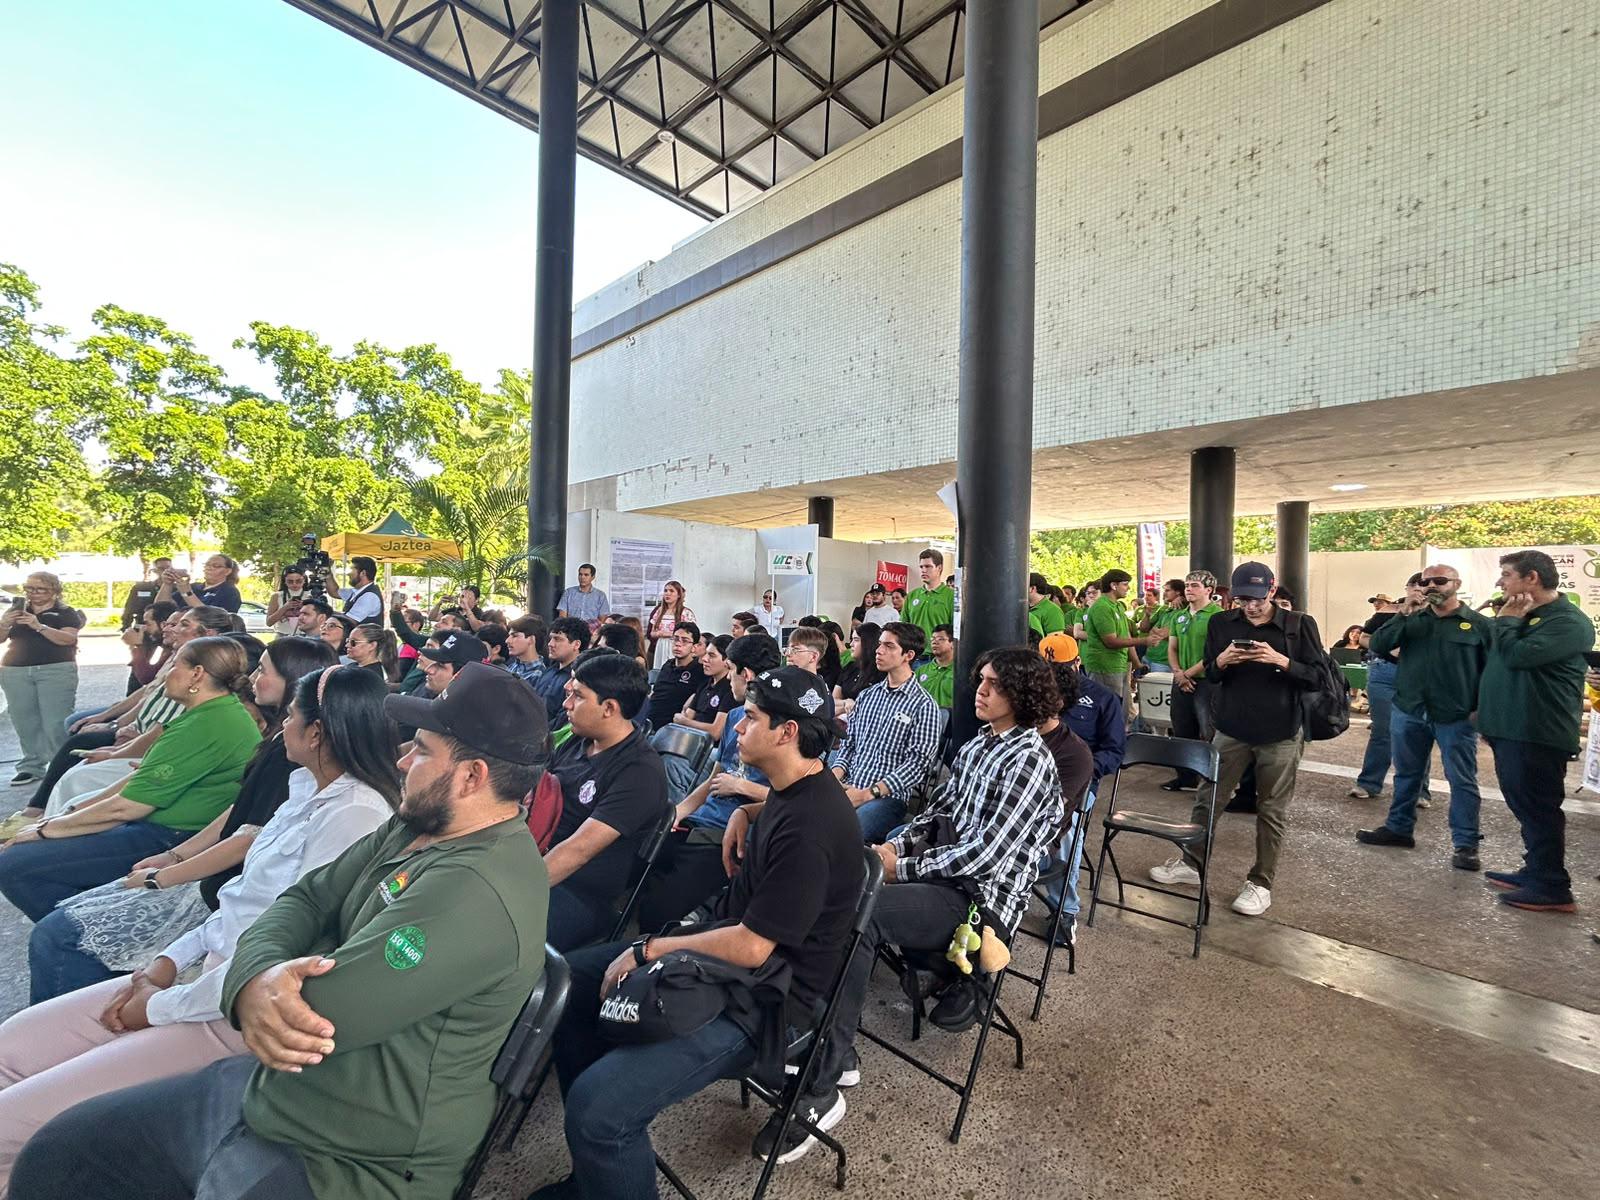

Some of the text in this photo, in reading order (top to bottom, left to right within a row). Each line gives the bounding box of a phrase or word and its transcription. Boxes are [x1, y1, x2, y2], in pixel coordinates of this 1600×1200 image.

[380, 540, 432, 552] Jaztea
[389, 932, 404, 946] ISO
[401, 943, 422, 964] 14001
[600, 995, 640, 1023] adidas
